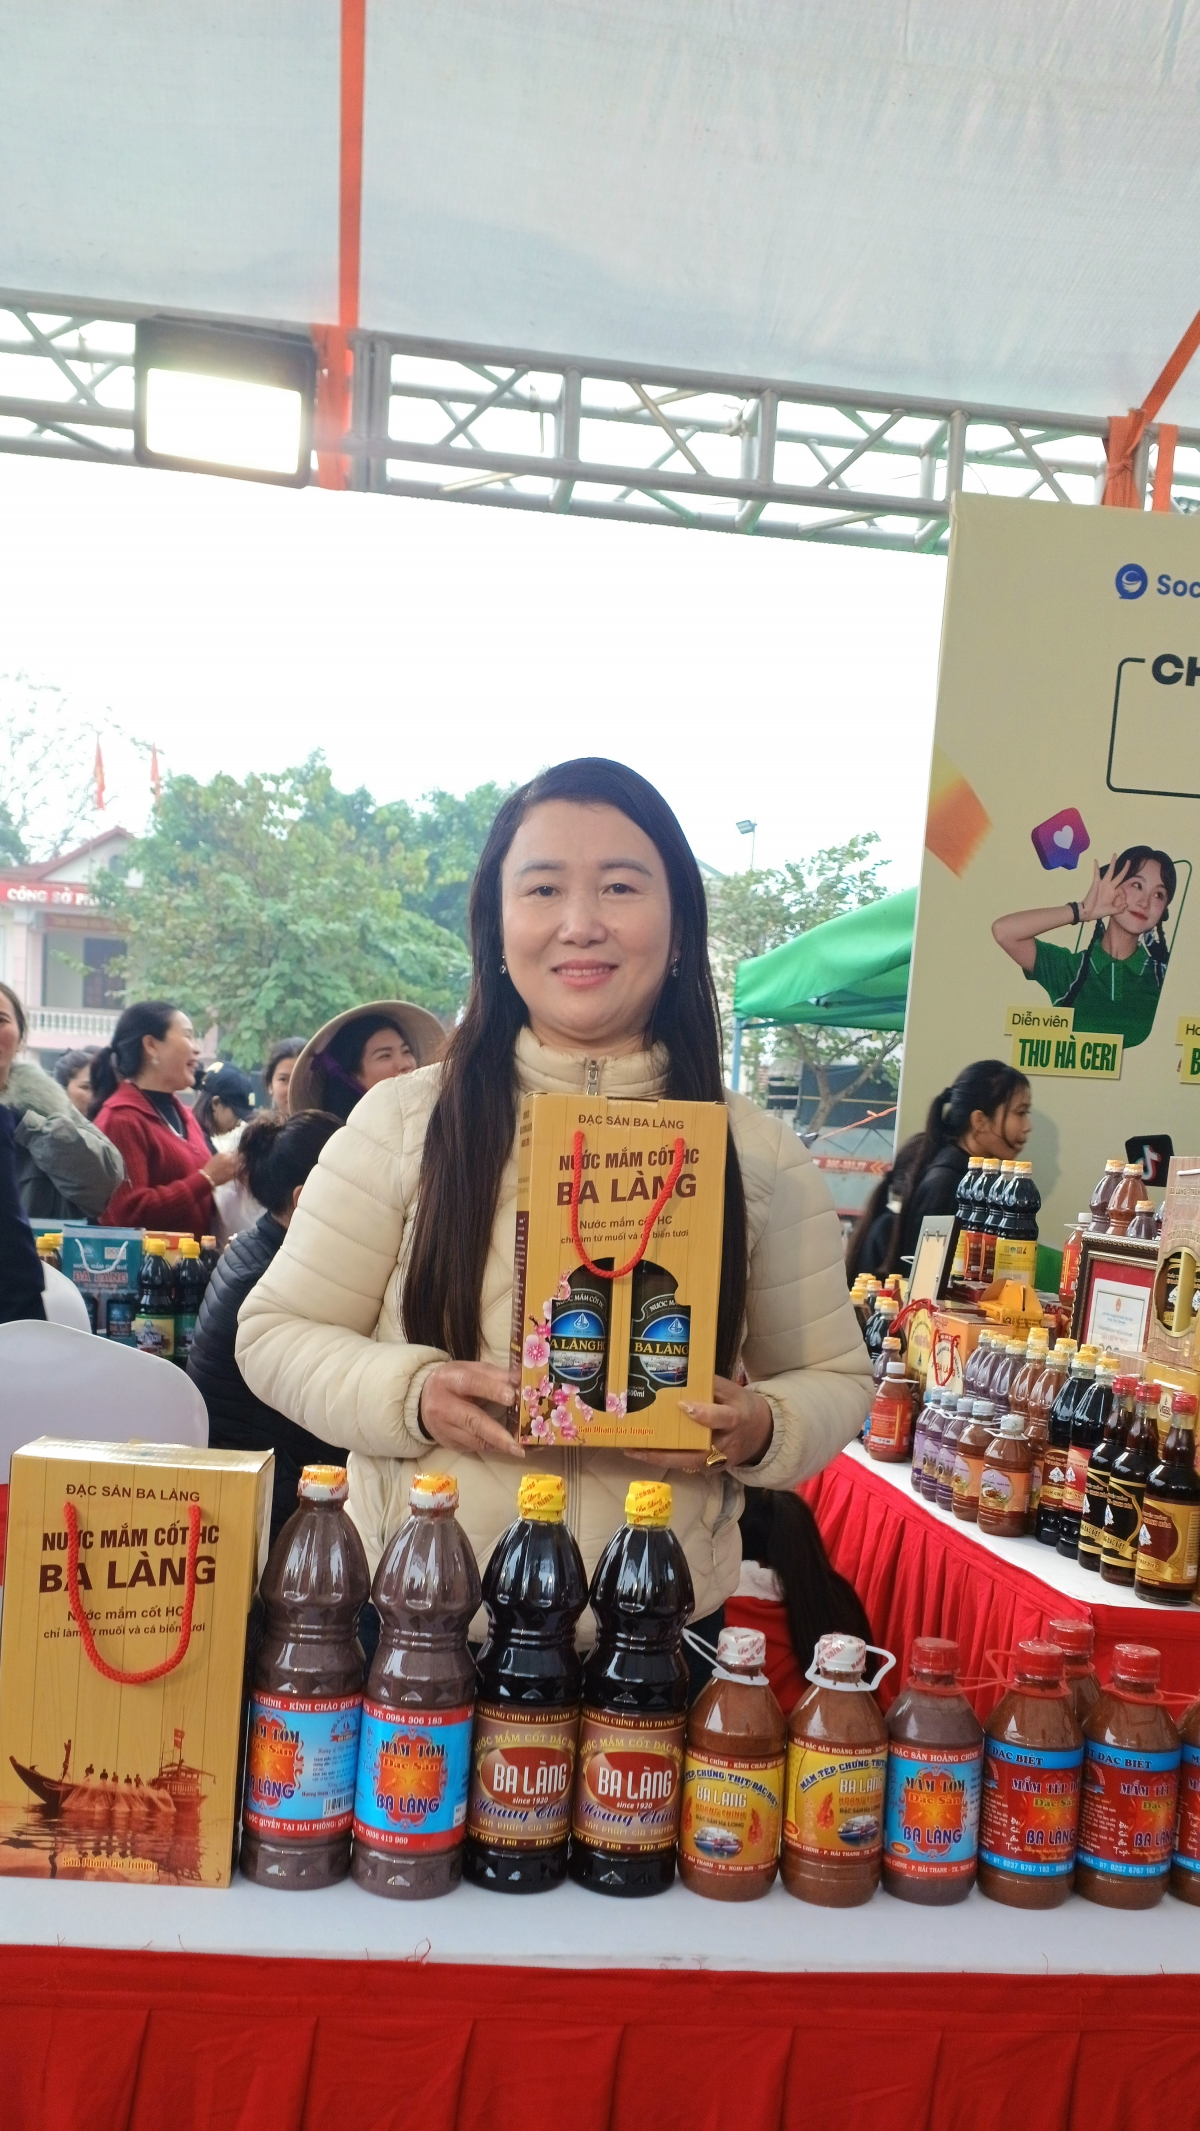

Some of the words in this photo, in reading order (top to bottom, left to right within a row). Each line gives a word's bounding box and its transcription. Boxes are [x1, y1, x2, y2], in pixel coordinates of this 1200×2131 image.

[1012, 1011, 1040, 1026] Diễn
[1043, 1013, 1069, 1029] viên
[1019, 1039, 1052, 1068] THU
[1054, 1035, 1077, 1070] HÀ
[1080, 1041, 1118, 1072] CERI
[633, 1117, 650, 1128] BA
[556, 1180, 600, 1206] BA
[579, 1217, 607, 1230] Nước
[657, 1215, 673, 1226] HC
[634, 1342, 653, 1353] BA
[655, 1341, 689, 1355] LÀNG
[101, 1485, 132, 1498] SẢN
[136, 1487, 156, 1499] BA
[160, 1488, 201, 1502] LÀNG
[100, 1523, 148, 1549] MẮM
[153, 1520, 190, 1546] CỐT
[39, 1562, 93, 1593] BA
[107, 1551, 216, 1589] LÀNG
[141, 1604, 162, 1618] cốt
[165, 1606, 186, 1618] HC
[62, 1625, 82, 1637] làm
[98, 1623, 126, 1636] muối
[128, 1624, 141, 1635] và
[143, 1624, 156, 1635] cá
[289, 1701, 312, 1712] KÍNH
[314, 1701, 338, 1712] CHÀO
[385, 1714, 405, 1724] 0984
[831, 1745, 854, 1756] HOÀNG
[911, 1750, 928, 1761] SẢN
[930, 1752, 960, 1763] HOÀNG
[992, 1746, 1014, 1761] ĐẶC
[1015, 1752, 1045, 1767] BIỆT
[1097, 1752, 1122, 1768] ĐẶC
[1124, 1757, 1153, 1772] BIỆT
[493, 1762, 518, 1795] BA
[522, 1760, 568, 1796] LÀNG
[597, 1765, 622, 1798] BA
[626, 1765, 673, 1801] LÀNG
[839, 1777, 857, 1795] BA
[859, 1773, 884, 1794] LÀNG
[258, 1775, 295, 1799] LÀNG
[376, 1793, 394, 1811] BA
[399, 1793, 441, 1814] LÀNG
[512, 1796, 531, 1805] since
[532, 1796, 549, 1805] 1920
[696, 1784, 711, 1803] BA
[714, 1787, 748, 1809] LÀNG
[908, 1792, 935, 1806] Đặc
[937, 1792, 962, 1806] Sản
[616, 1801, 635, 1809] since
[636, 1801, 653, 1810] 1920
[283, 1821, 295, 1832] TẠI
[903, 1825, 922, 1843] BA
[925, 1825, 963, 1845] LÀNG
[1026, 1828, 1045, 1846] BA
[1048, 1826, 1076, 1845] LÀNG
[1133, 1831, 1152, 1848] BA
[1038, 1862, 1050, 1873] 183
[1110, 1861, 1127, 1873] 0237
[1128, 1864, 1145, 1875] 6767
